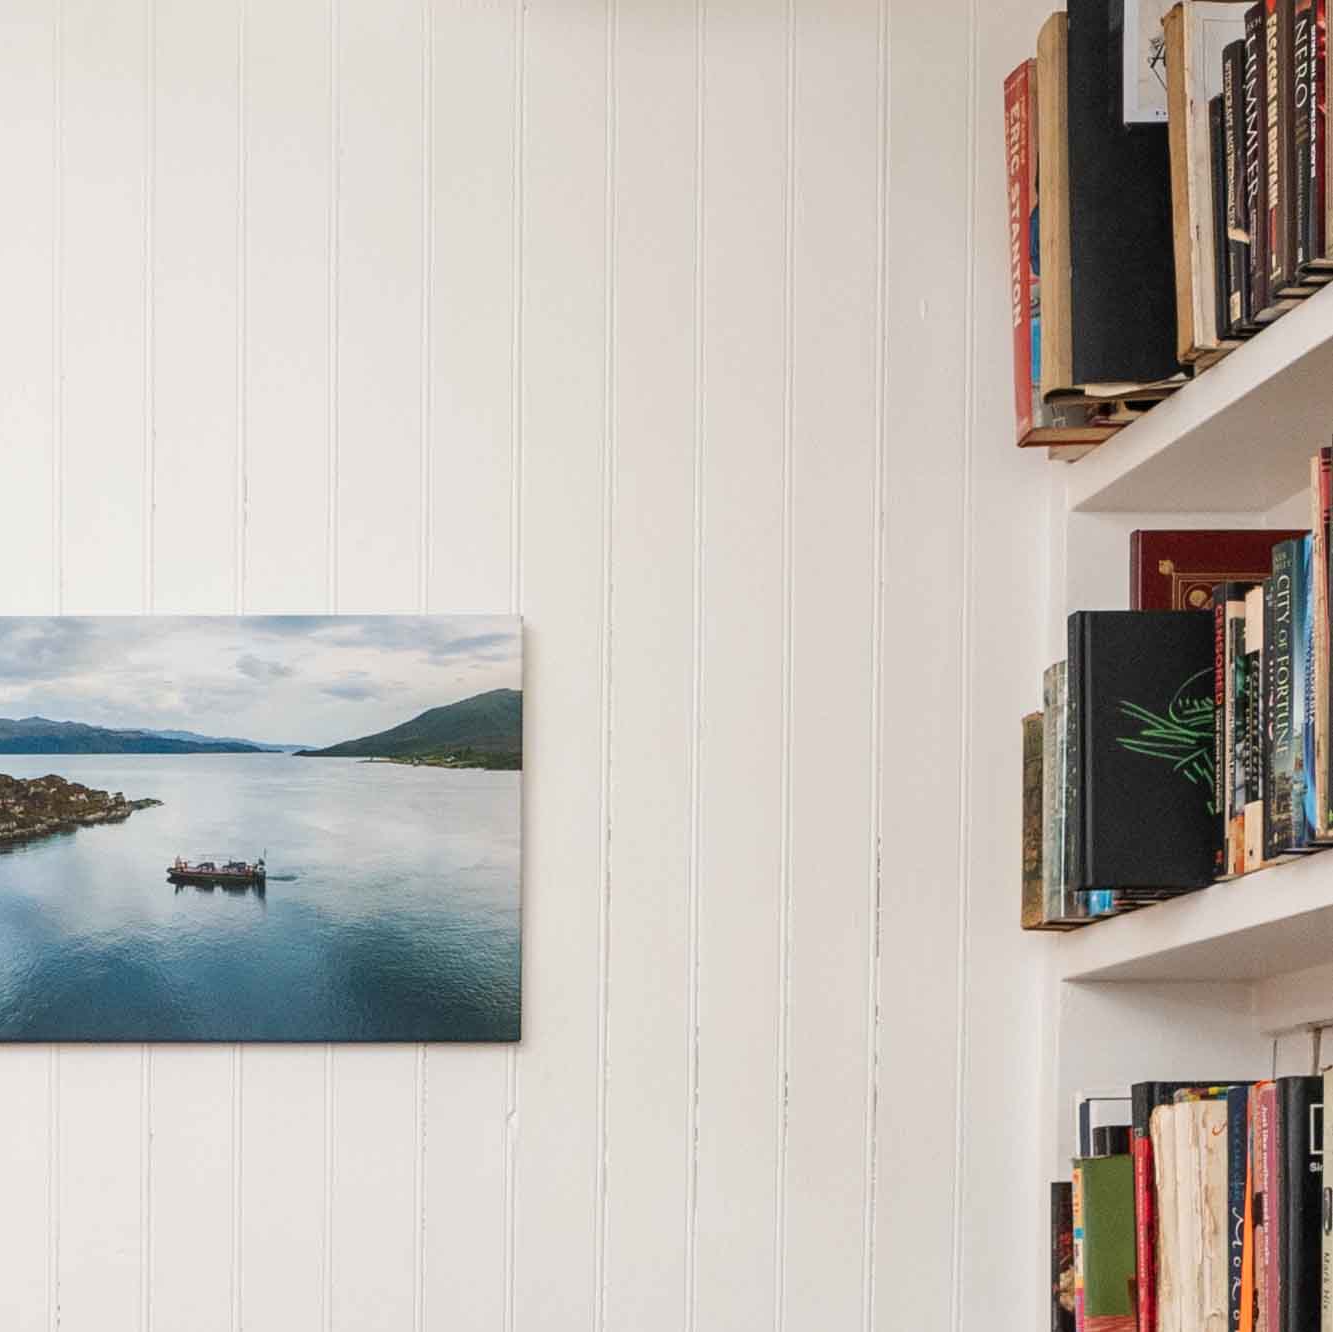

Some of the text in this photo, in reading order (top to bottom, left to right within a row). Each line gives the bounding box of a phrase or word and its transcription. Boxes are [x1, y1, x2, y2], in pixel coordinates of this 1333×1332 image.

[1267, 13, 1278, 100] FASCISM
[1294, 18, 1308, 109] NERO
[1245, 35, 1259, 207] HIMMLER
[1009, 102, 1022, 329] ERIC STANTON
[1277, 575, 1291, 624] CITY
[1278, 629, 1288, 649] OF
[1276, 656, 1290, 756] FORTUNE
